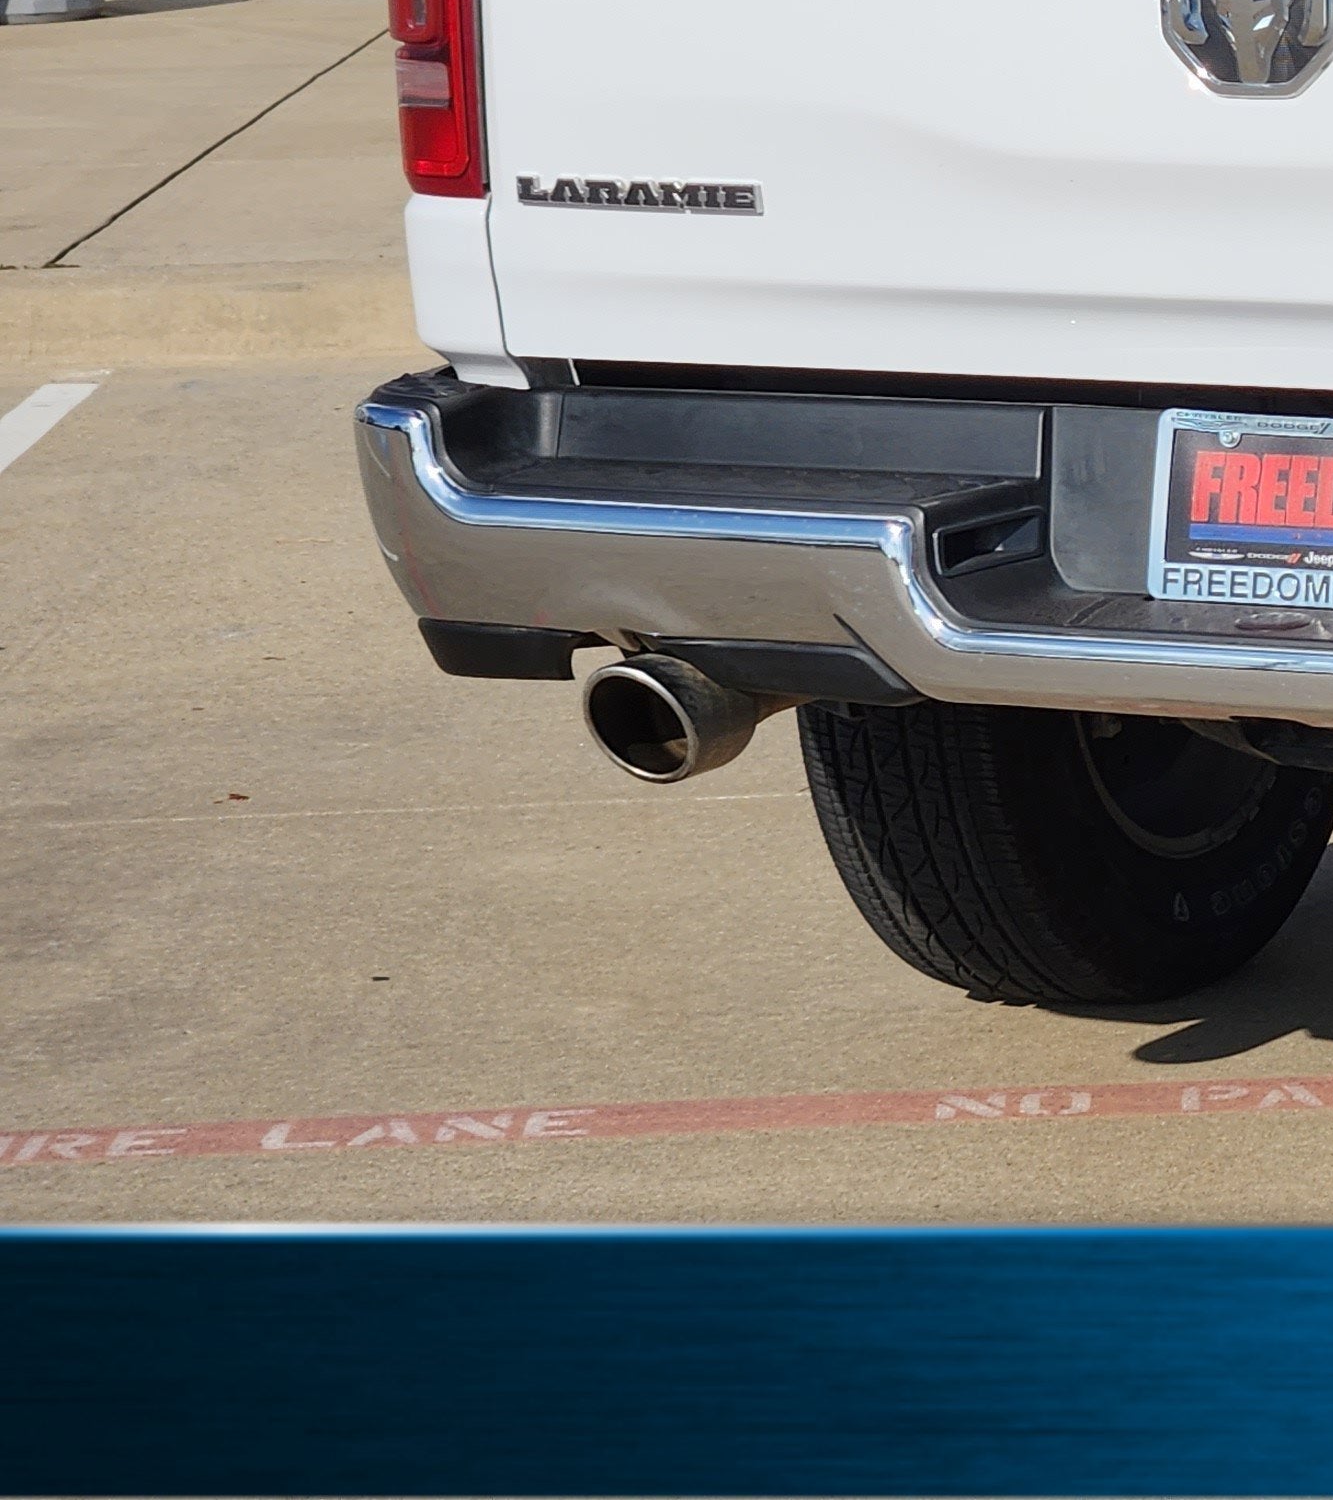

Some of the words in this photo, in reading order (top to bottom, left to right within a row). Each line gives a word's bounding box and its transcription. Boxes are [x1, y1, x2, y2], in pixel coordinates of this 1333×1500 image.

[516, 173, 764, 216] LARAMIE
[1161, 566, 1332, 604] FREEDOM
[934, 1091, 1093, 1121] NO
[260, 1108, 596, 1149] LANE
